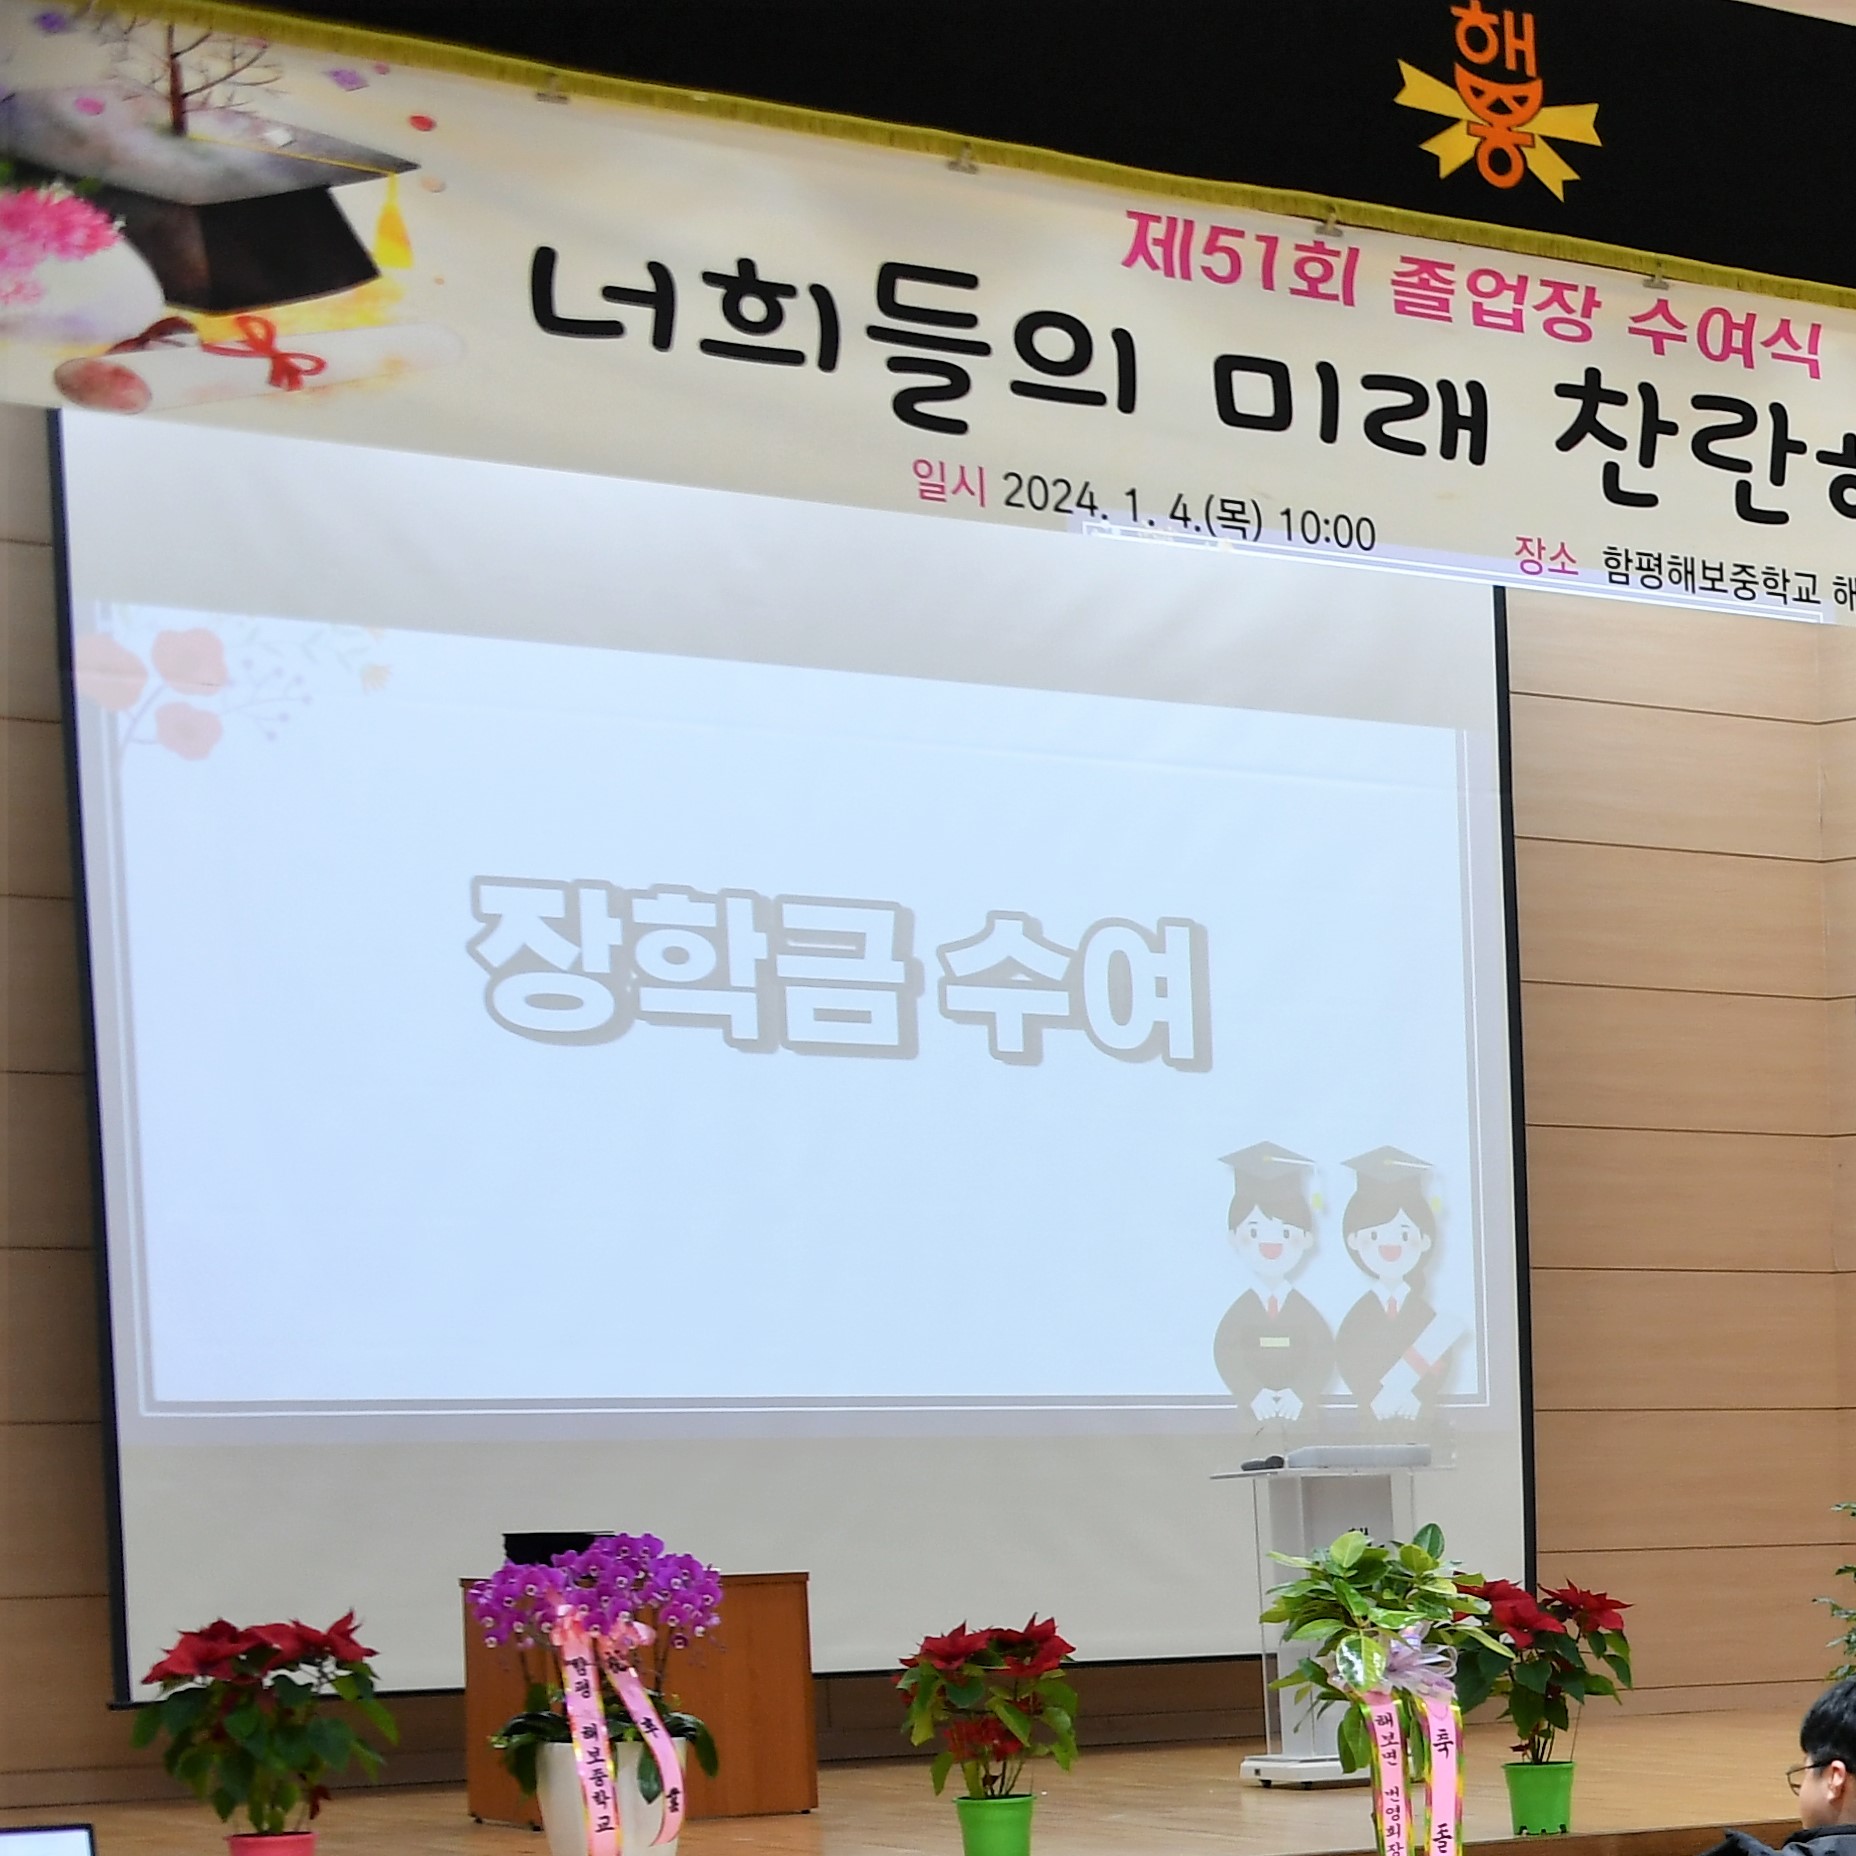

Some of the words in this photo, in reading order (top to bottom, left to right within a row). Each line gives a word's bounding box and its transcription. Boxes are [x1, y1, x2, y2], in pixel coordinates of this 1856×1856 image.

[1122, 209, 1360, 307] 제51회
[1389, 252, 1602, 344] 졸업장
[1627, 297, 1823, 380] 수여식
[529, 244, 1138, 436] 너희들의
[1212, 352, 1491, 467] 미래
[912, 458, 988, 508] 일시
[1001, 471, 1110, 522] 2024.
[1123, 488, 1157, 528] 1.
[1278, 508, 1378, 552] 10:00
[1513, 535, 1580, 577] 장소
[1601, 544, 1823, 606] 함평해보중학교
[466, 875, 926, 1060] 장학금
[938, 908, 1214, 1074] 수여
[569, 1656, 592, 1699] 함평
[580, 1723, 616, 1833] 해보중학교
[1375, 1712, 1399, 1766] 해보면
